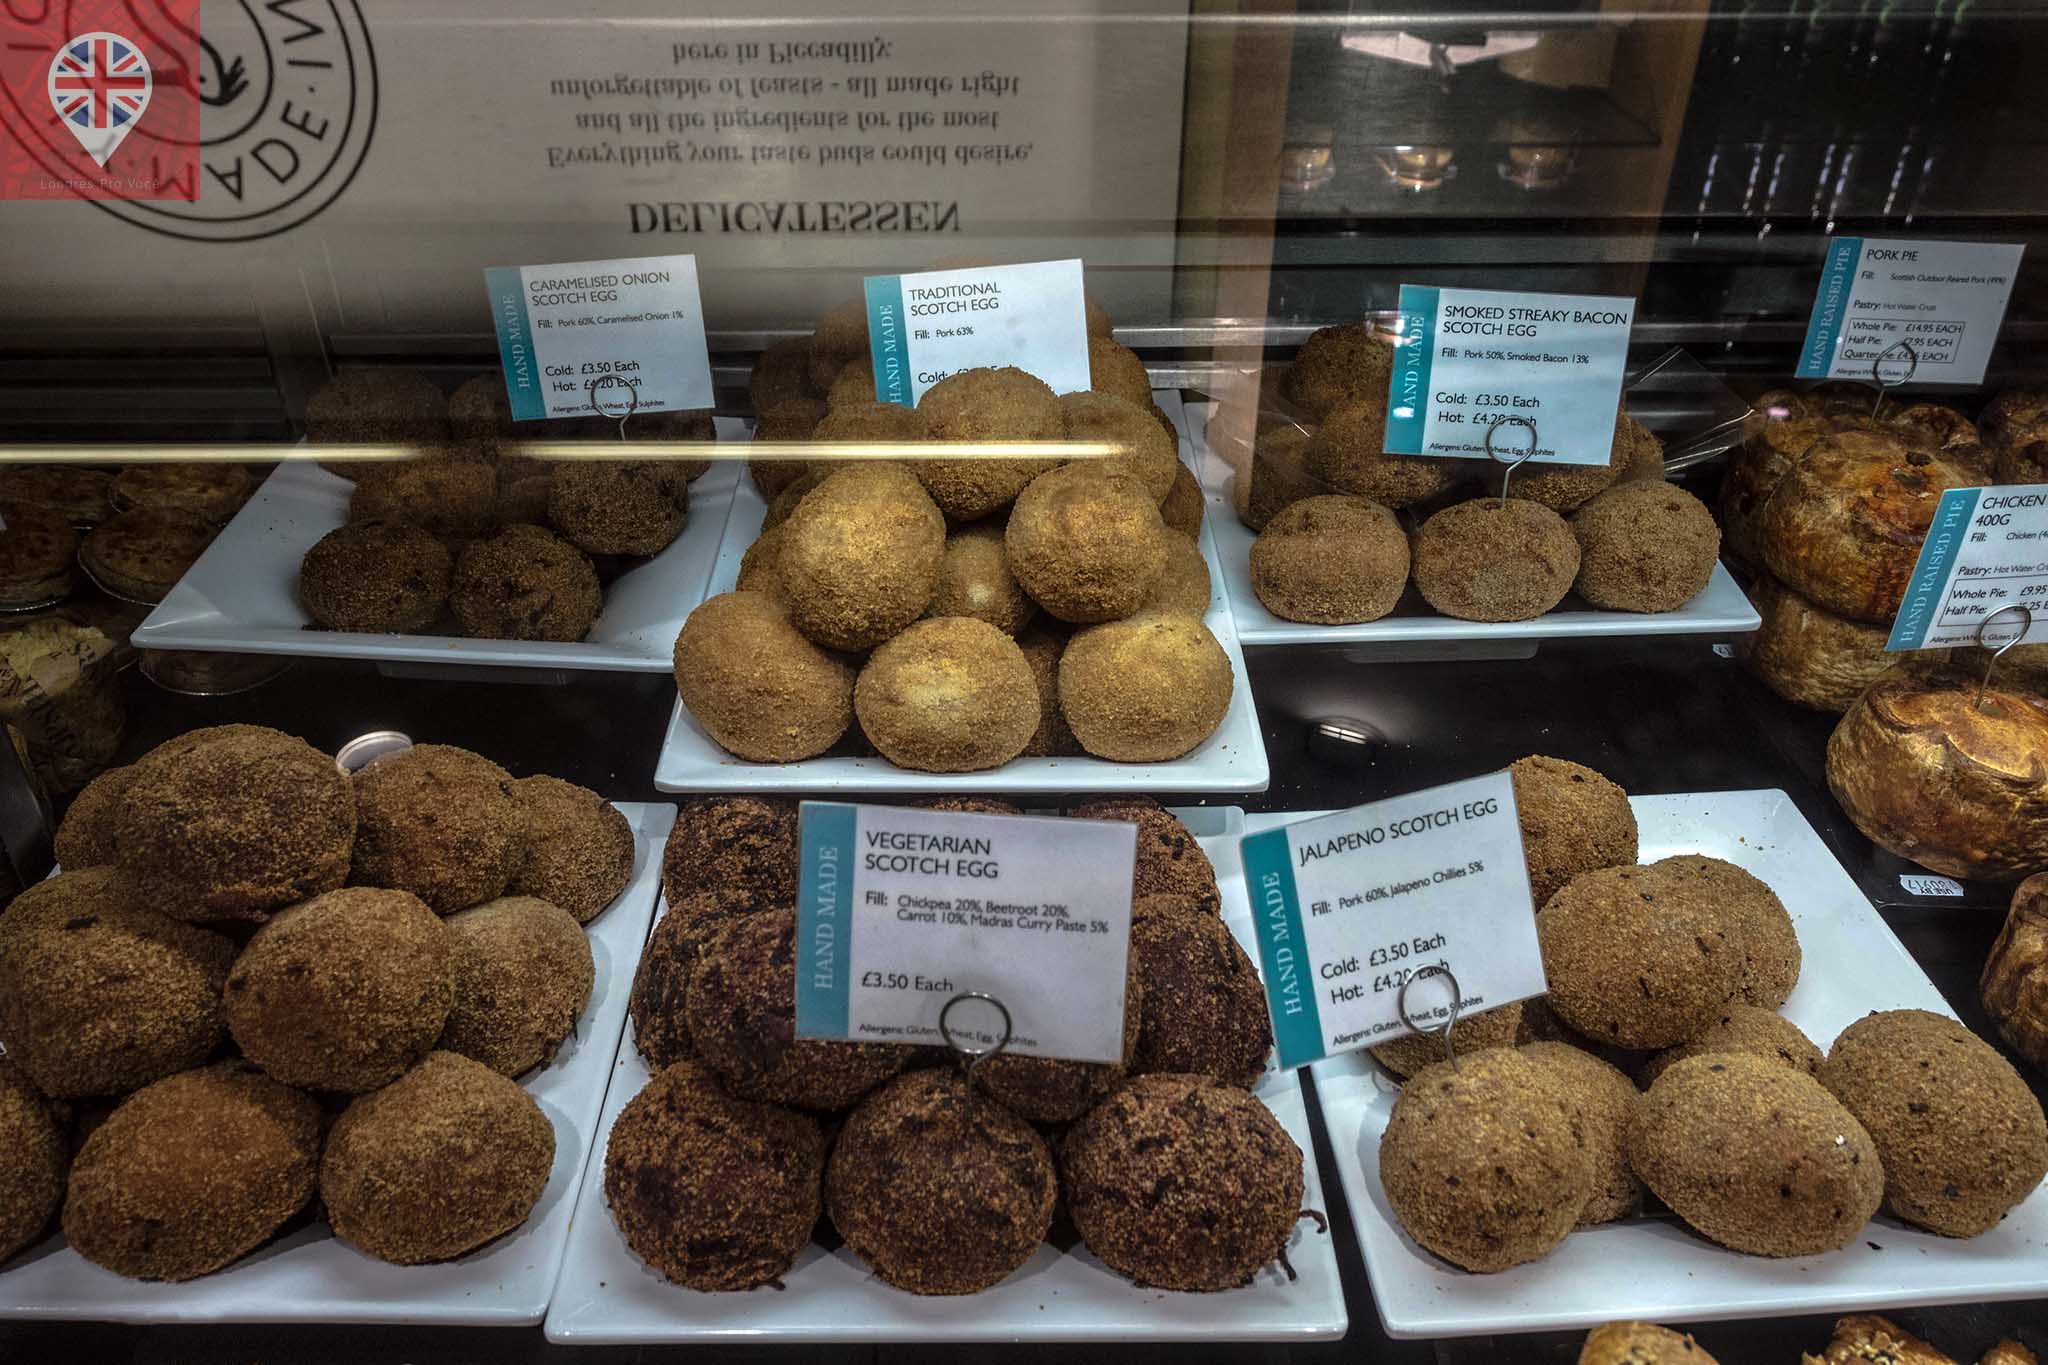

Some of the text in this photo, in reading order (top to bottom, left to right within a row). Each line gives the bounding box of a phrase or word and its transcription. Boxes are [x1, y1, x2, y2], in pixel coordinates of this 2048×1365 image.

[1866, 248, 1919, 262] PORK PIE
[530, 271, 671, 292] CARAMELISED ONION
[908, 281, 1002, 302] TRADITIONAL
[532, 290, 618, 307] SCOTCH EGG
[910, 297, 1000, 317] SCOTCH EGG
[1808, 246, 1852, 370] HAND RAISED PIE
[537, 319, 553, 329] Fill:
[558, 318, 576, 328] Pork
[644, 311, 670, 321] Onion
[672, 310, 684, 320] 1%
[1444, 304, 1628, 325] SMOKED STREAKY BACON
[914, 326, 974, 340] Fill: Pork 63%
[1443, 320, 1538, 338] SCOTCH EGG
[1852, 321, 1881, 331] Whole
[1935, 324, 1962, 334] EACH
[502, 293, 532, 390] HAND MADE
[1406, 315, 1425, 369] MADE
[1847, 335, 1867, 345] Half
[1927, 338, 1953, 347] EACH
[879, 303, 903, 404] HAND MADE
[1441, 347, 1458, 358] Fill:
[1464, 350, 1484, 360] Pork
[1507, 351, 1541, 362] Smoked
[1543, 353, 1569, 363] Bacon
[1844, 348, 1949, 361] Quarter EACH
[545, 360, 640, 377] Cold: £3.50 Each
[553, 381, 577, 392] Hot:
[584, 378, 614, 390] £420
[1435, 391, 1541, 409] Cold: £3.50 Each
[1438, 411, 1465, 424] Hot:
[1982, 494, 2048, 509] CHICKEN
[1975, 513, 2012, 527] 400G
[1970, 531, 1988, 543] Fill:
[2006, 531, 2037, 541] Chicken
[1900, 499, 1966, 642] HAND RAISED PIE
[1957, 565, 1992, 578] Pastry:
[1993, 565, 2010, 574] Hot
[1952, 585, 2048, 599] Whole Pie: £9.95
[1945, 605, 1988, 616] Half Pie:
[1299, 797, 1499, 867] JALAPENO SCOTCH EGG
[865, 830, 991, 856] VEGETARIAN
[865, 854, 999, 880] SCOTCH EGG
[1311, 901, 1332, 917] Fill:
[1338, 893, 1364, 910] Pork
[1390, 877, 1431, 898] Jalapeno
[1432, 866, 1467, 884] Chillies
[1468, 860, 1485, 875] 5%
[865, 890, 888, 907] Fill:
[897, 894, 951, 911] Chickpea
[986, 900, 1038, 917] Beetroot
[813, 846, 839, 990] HAND MADE
[896, 908, 937, 923] Carrot
[970, 913, 1014, 929] Madras
[1016, 917, 1052, 933] Curry
[1055, 919, 1087, 933] Paste
[1090, 919, 1109, 935] 5%
[1262, 871, 1303, 1016] HAND MADE
[1320, 932, 1447, 980] Cold: £3.50 Each
[861, 972, 954, 993] £3.50 Each
[1330, 985, 1365, 1005] Hot:
